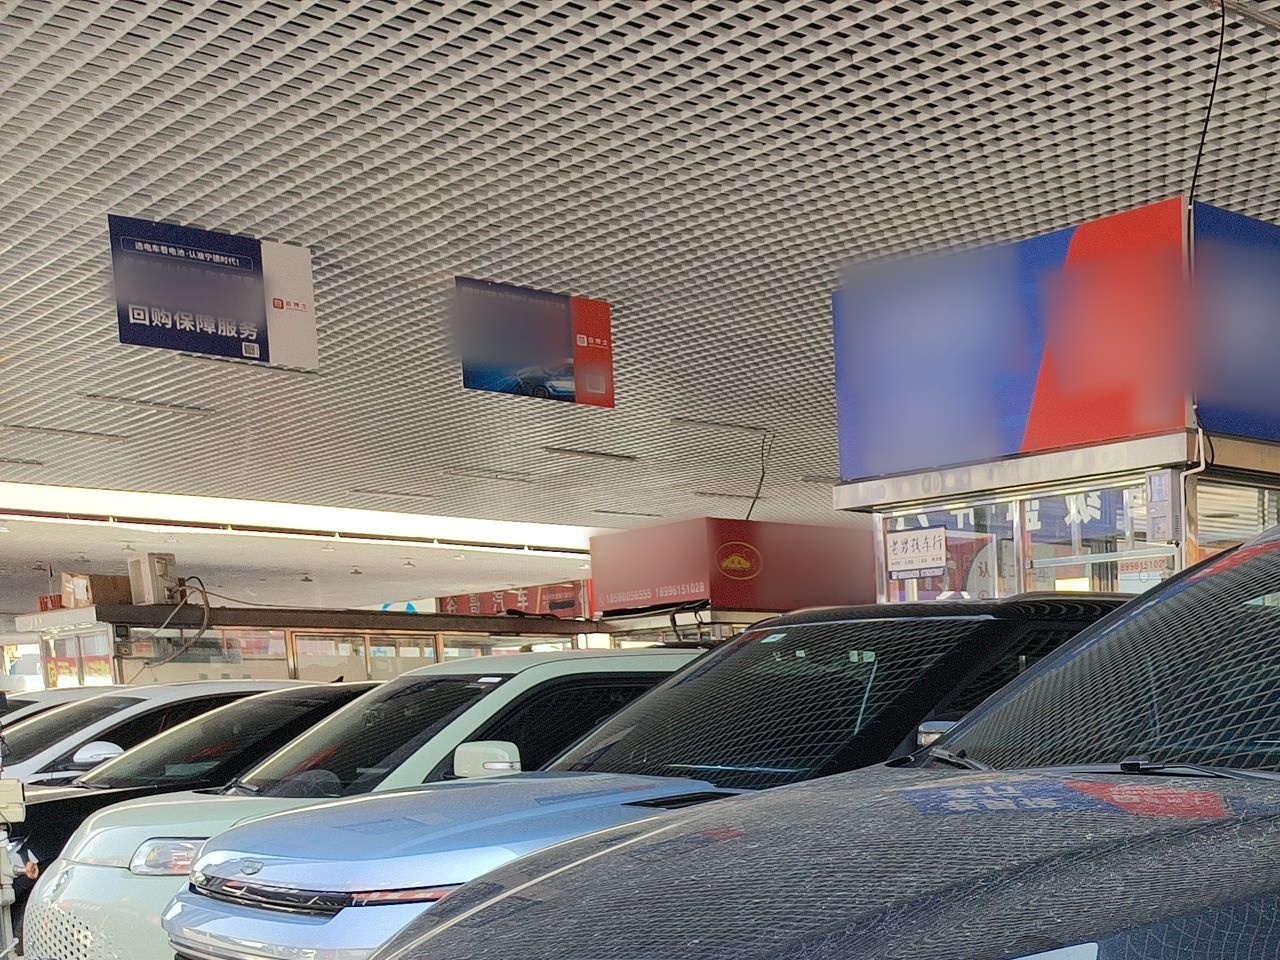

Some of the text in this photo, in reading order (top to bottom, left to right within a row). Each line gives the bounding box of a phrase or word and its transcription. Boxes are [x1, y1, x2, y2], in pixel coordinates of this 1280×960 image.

[128, 304, 258, 341] 回购保障服务
